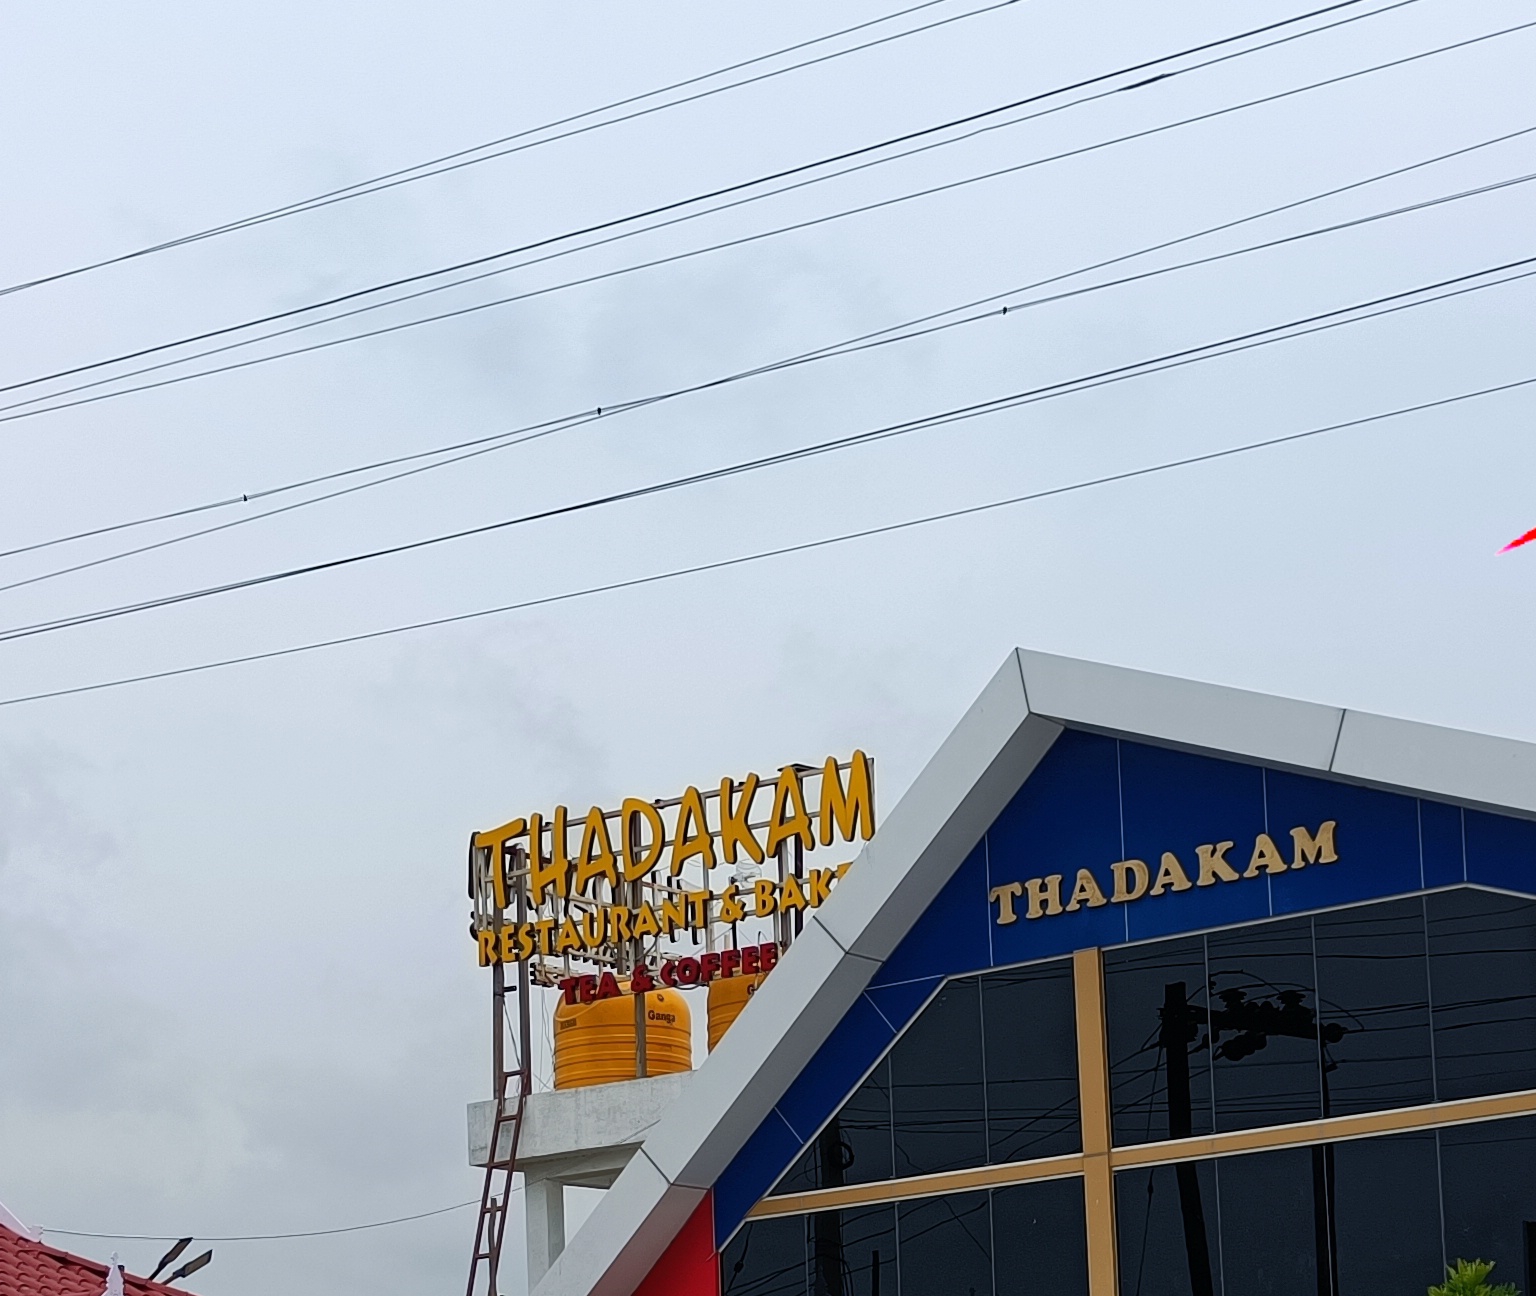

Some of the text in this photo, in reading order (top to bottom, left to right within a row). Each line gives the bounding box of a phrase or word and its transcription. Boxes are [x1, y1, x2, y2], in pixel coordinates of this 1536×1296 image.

[474, 750, 876, 909] THADAKAM
[989, 820, 1339, 925] THADAKAM
[477, 890, 713, 967] RESTAURANT
[720, 884, 747, 923] &
[560, 942, 778, 1006] TEA & COFFEE
[648, 1009, 676, 1024] Ganga
